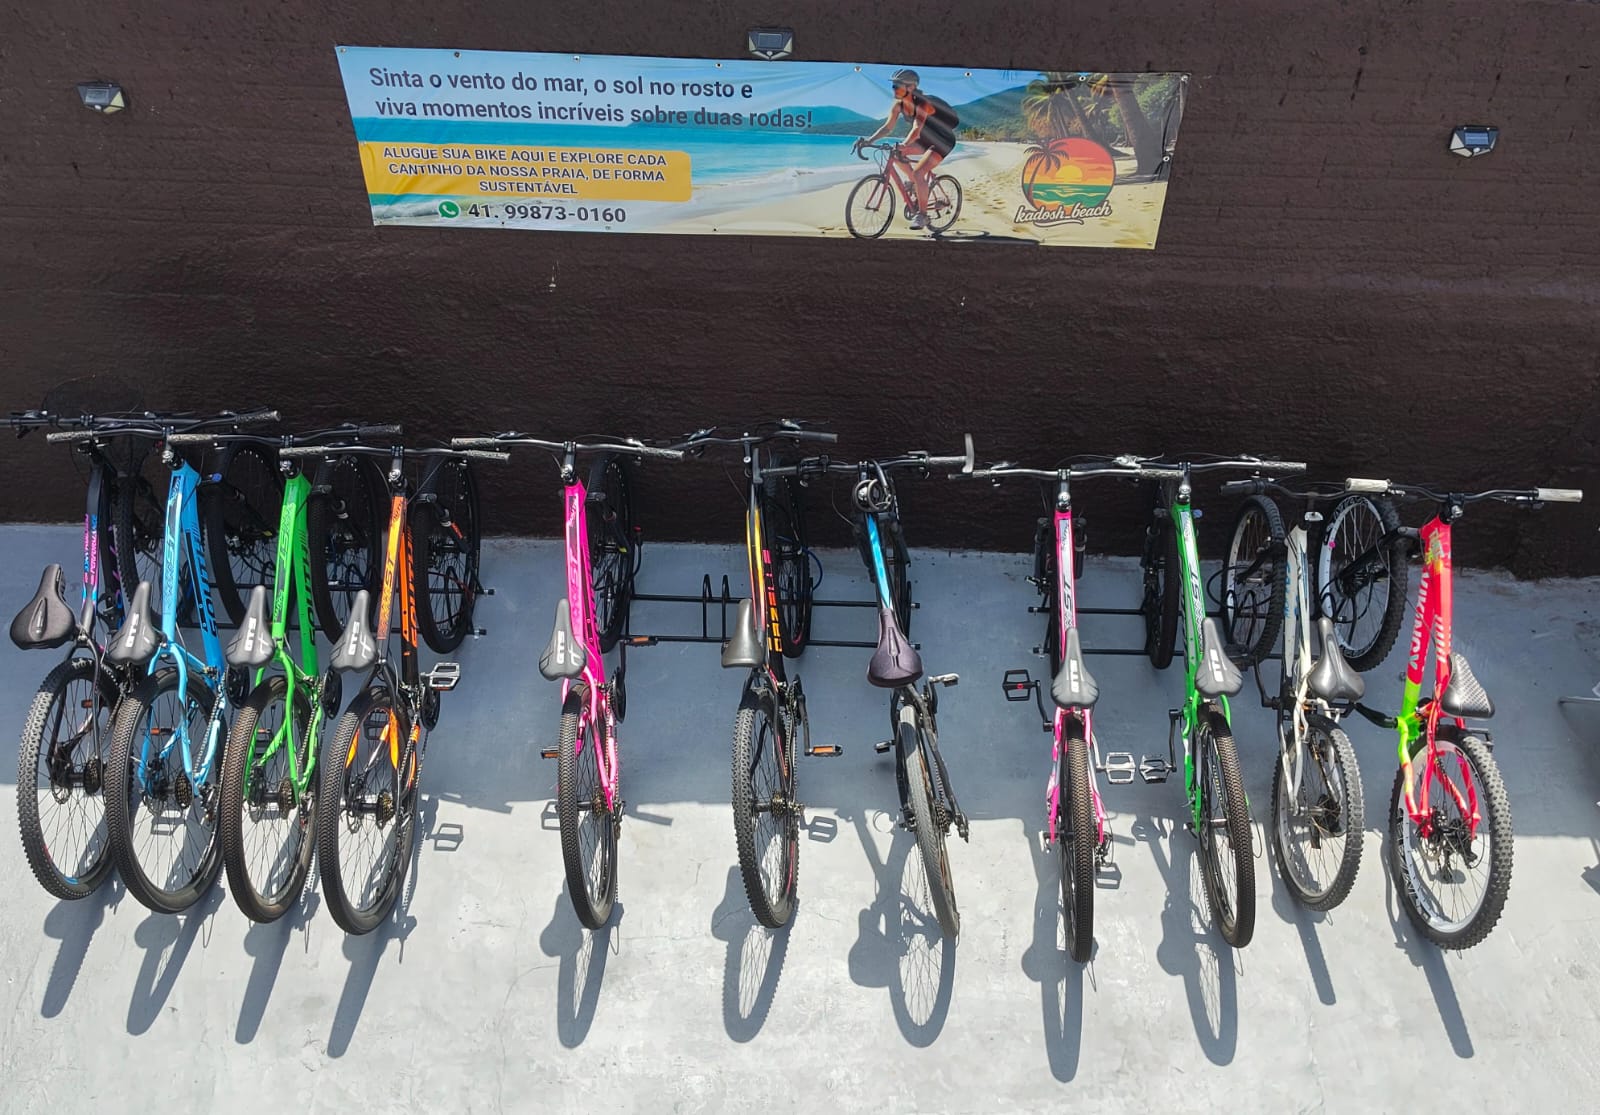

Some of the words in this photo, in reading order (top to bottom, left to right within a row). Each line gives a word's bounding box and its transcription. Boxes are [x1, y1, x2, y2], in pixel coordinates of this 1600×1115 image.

[369, 67, 424, 88] Sinta
[429, 73, 442, 89] o
[447, 72, 506, 91] vento
[511, 71, 538, 91] do
[543, 76, 588, 96] mar,
[593, 79, 607, 93] o
[613, 76, 643, 94] sol
[650, 81, 675, 96] no
[681, 80, 734, 98] rosto
[741, 84, 753, 98] e
[375, 97, 417, 116] viva
[422, 101, 532, 119] momentos
[537, 101, 624, 122] incríveis
[630, 105, 688, 124] sobre
[694, 107, 743, 126] duas
[749, 108, 813, 128] rodas!
[384, 147, 439, 160] ALUGUE
[442, 149, 471, 160] SUA
[475, 150, 507, 161] BIKE
[510, 150, 544, 162] AQUI
[548, 151, 557, 162] E
[560, 152, 624, 164] EXPLORE
[627, 154, 667, 166] CADA
[389, 163, 463, 175] CANTINHO
[466, 165, 486, 176] DA
[489, 166, 538, 177] NOSSA
[542, 167, 589, 181] PRAIA,
[593, 169, 610, 180] DE
[614, 169, 665, 181] FORMA
[479, 180, 578, 194] SUSTENTÁVEL
[468, 203, 499, 219] 41.
[504, 205, 626, 222] 99873-0160
